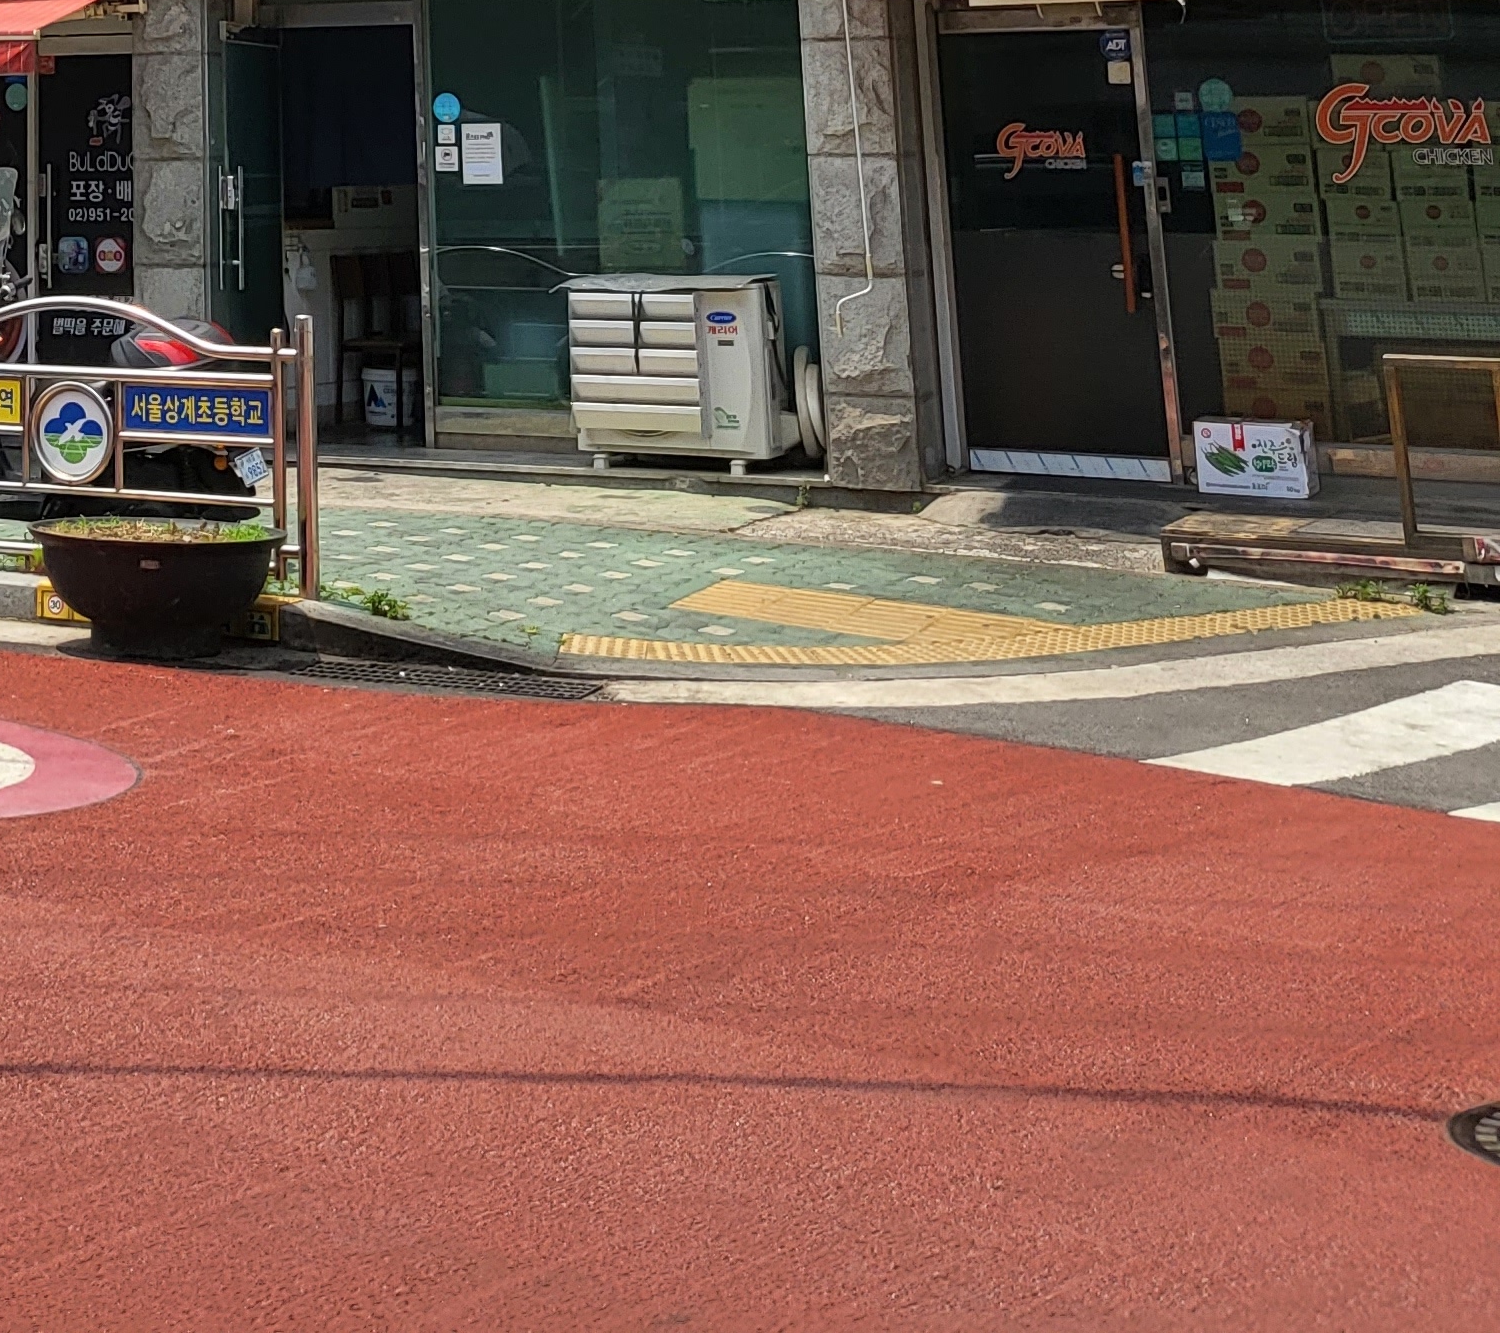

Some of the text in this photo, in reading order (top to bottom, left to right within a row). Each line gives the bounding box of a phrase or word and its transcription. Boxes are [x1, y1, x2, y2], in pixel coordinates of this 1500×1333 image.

[1105, 39, 1127, 51] ADT
[1412, 147, 1494, 166] CHICKEN
[131, 393, 265, 426] 서울상계초등학교
[50, 600, 61, 610] 30
